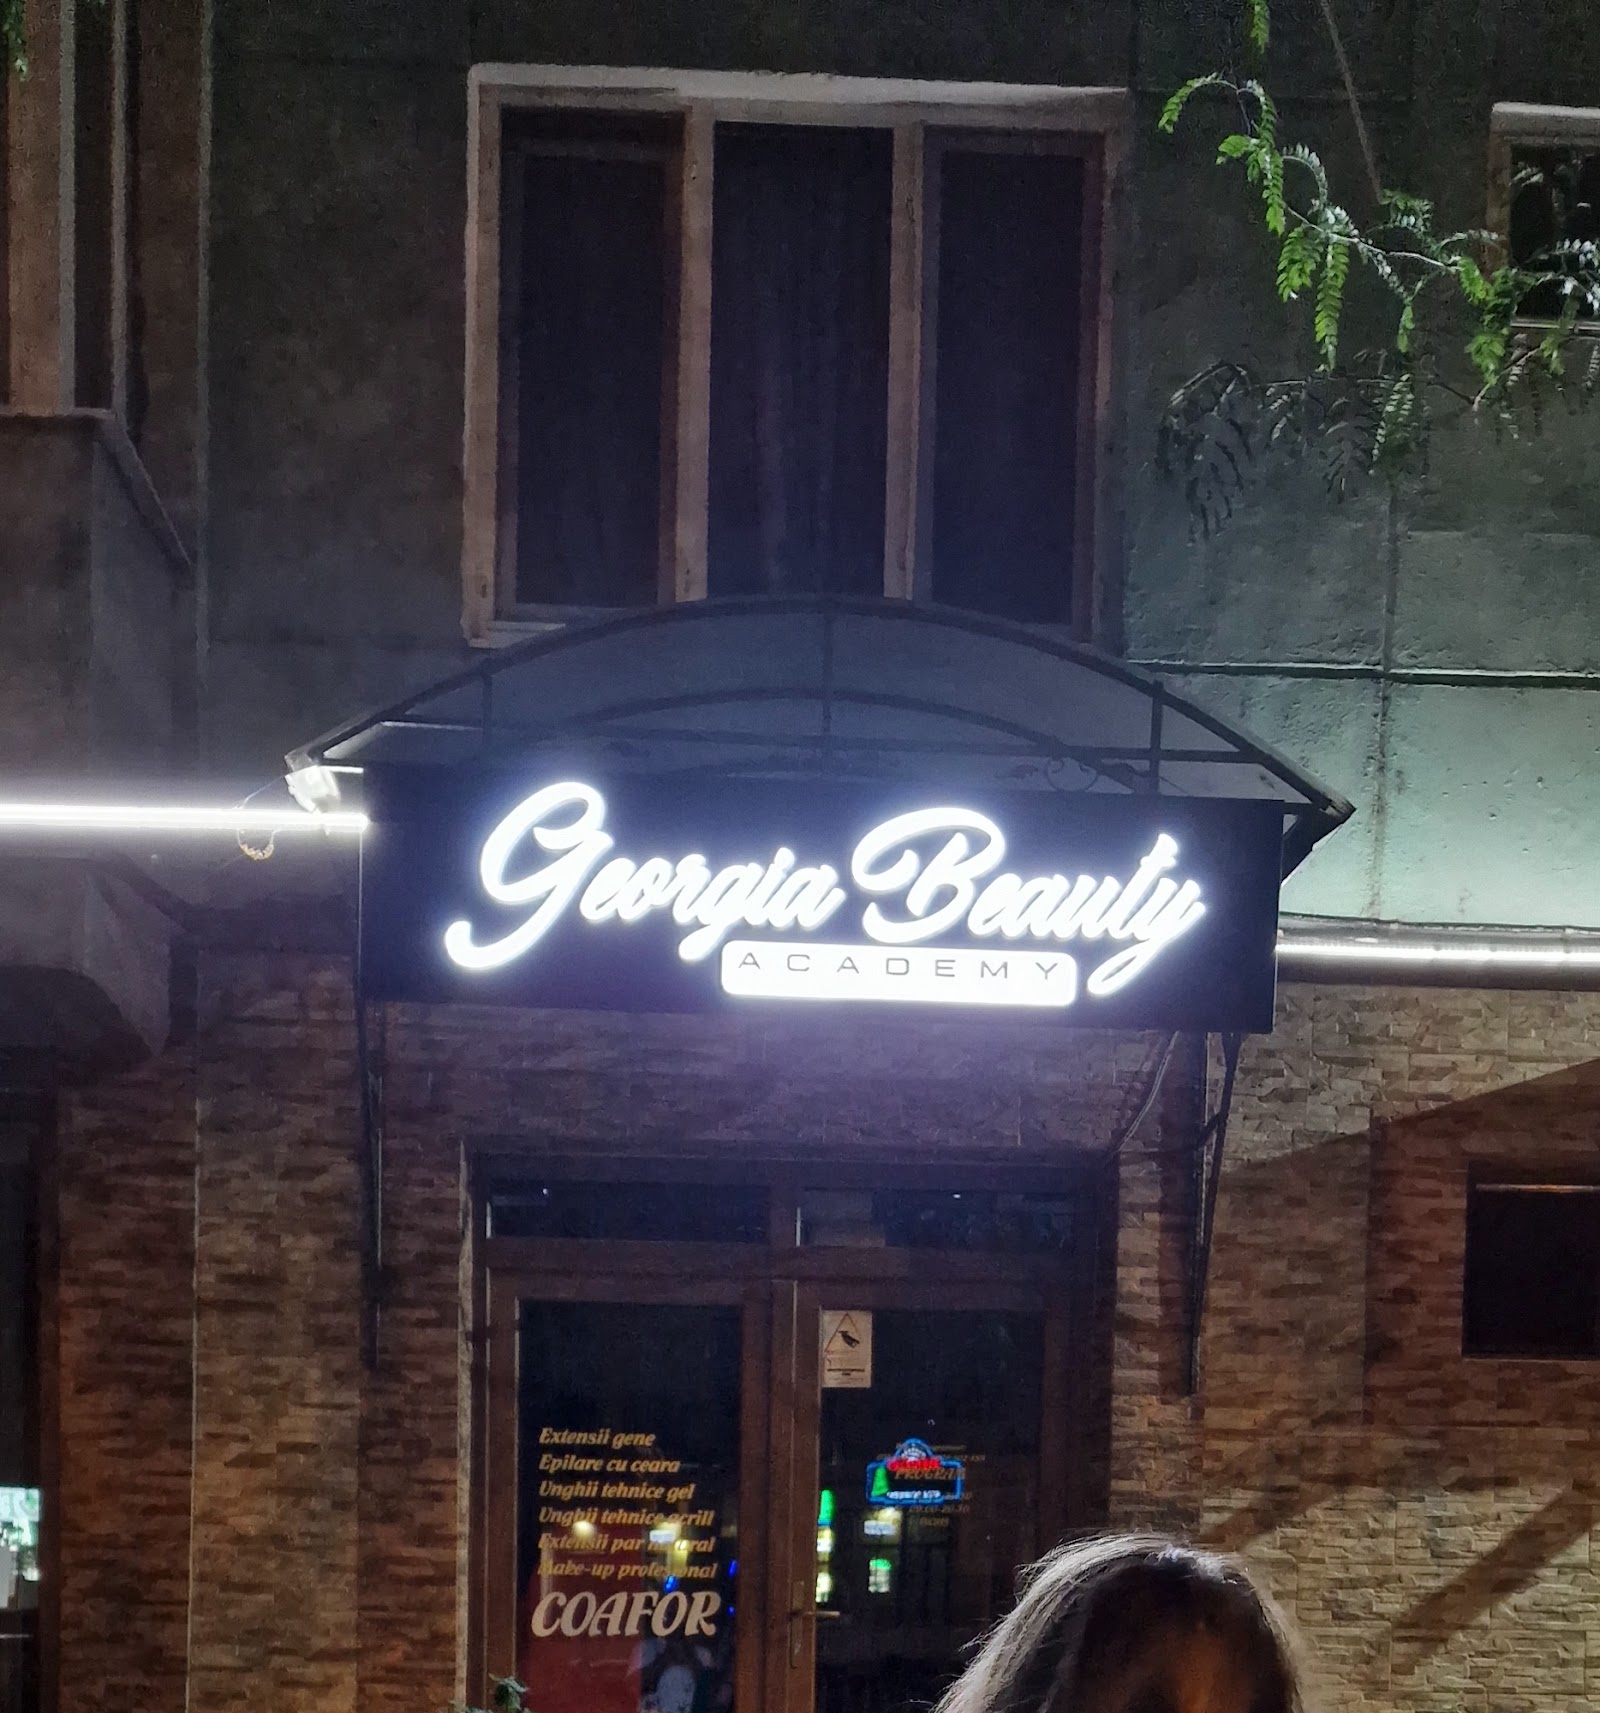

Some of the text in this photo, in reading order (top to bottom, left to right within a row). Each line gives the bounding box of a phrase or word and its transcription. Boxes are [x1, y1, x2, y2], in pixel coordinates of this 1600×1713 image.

[444, 780, 1206, 996] Georgia Beauty
[737, 951, 1059, 981] ACADEMY
[539, 1427, 656, 1449] Extensii gene
[538, 1454, 681, 1473] Epilare cu ceara
[539, 1480, 696, 1503] Unghii tehnice gel
[538, 1507, 598, 1526] Unghii
[600, 1509, 662, 1525] tehnice
[538, 1533, 717, 1558] Extensii par nral
[537, 1559, 719, 1581] Make-up profesonal
[531, 1591, 722, 1638] COAFOR
